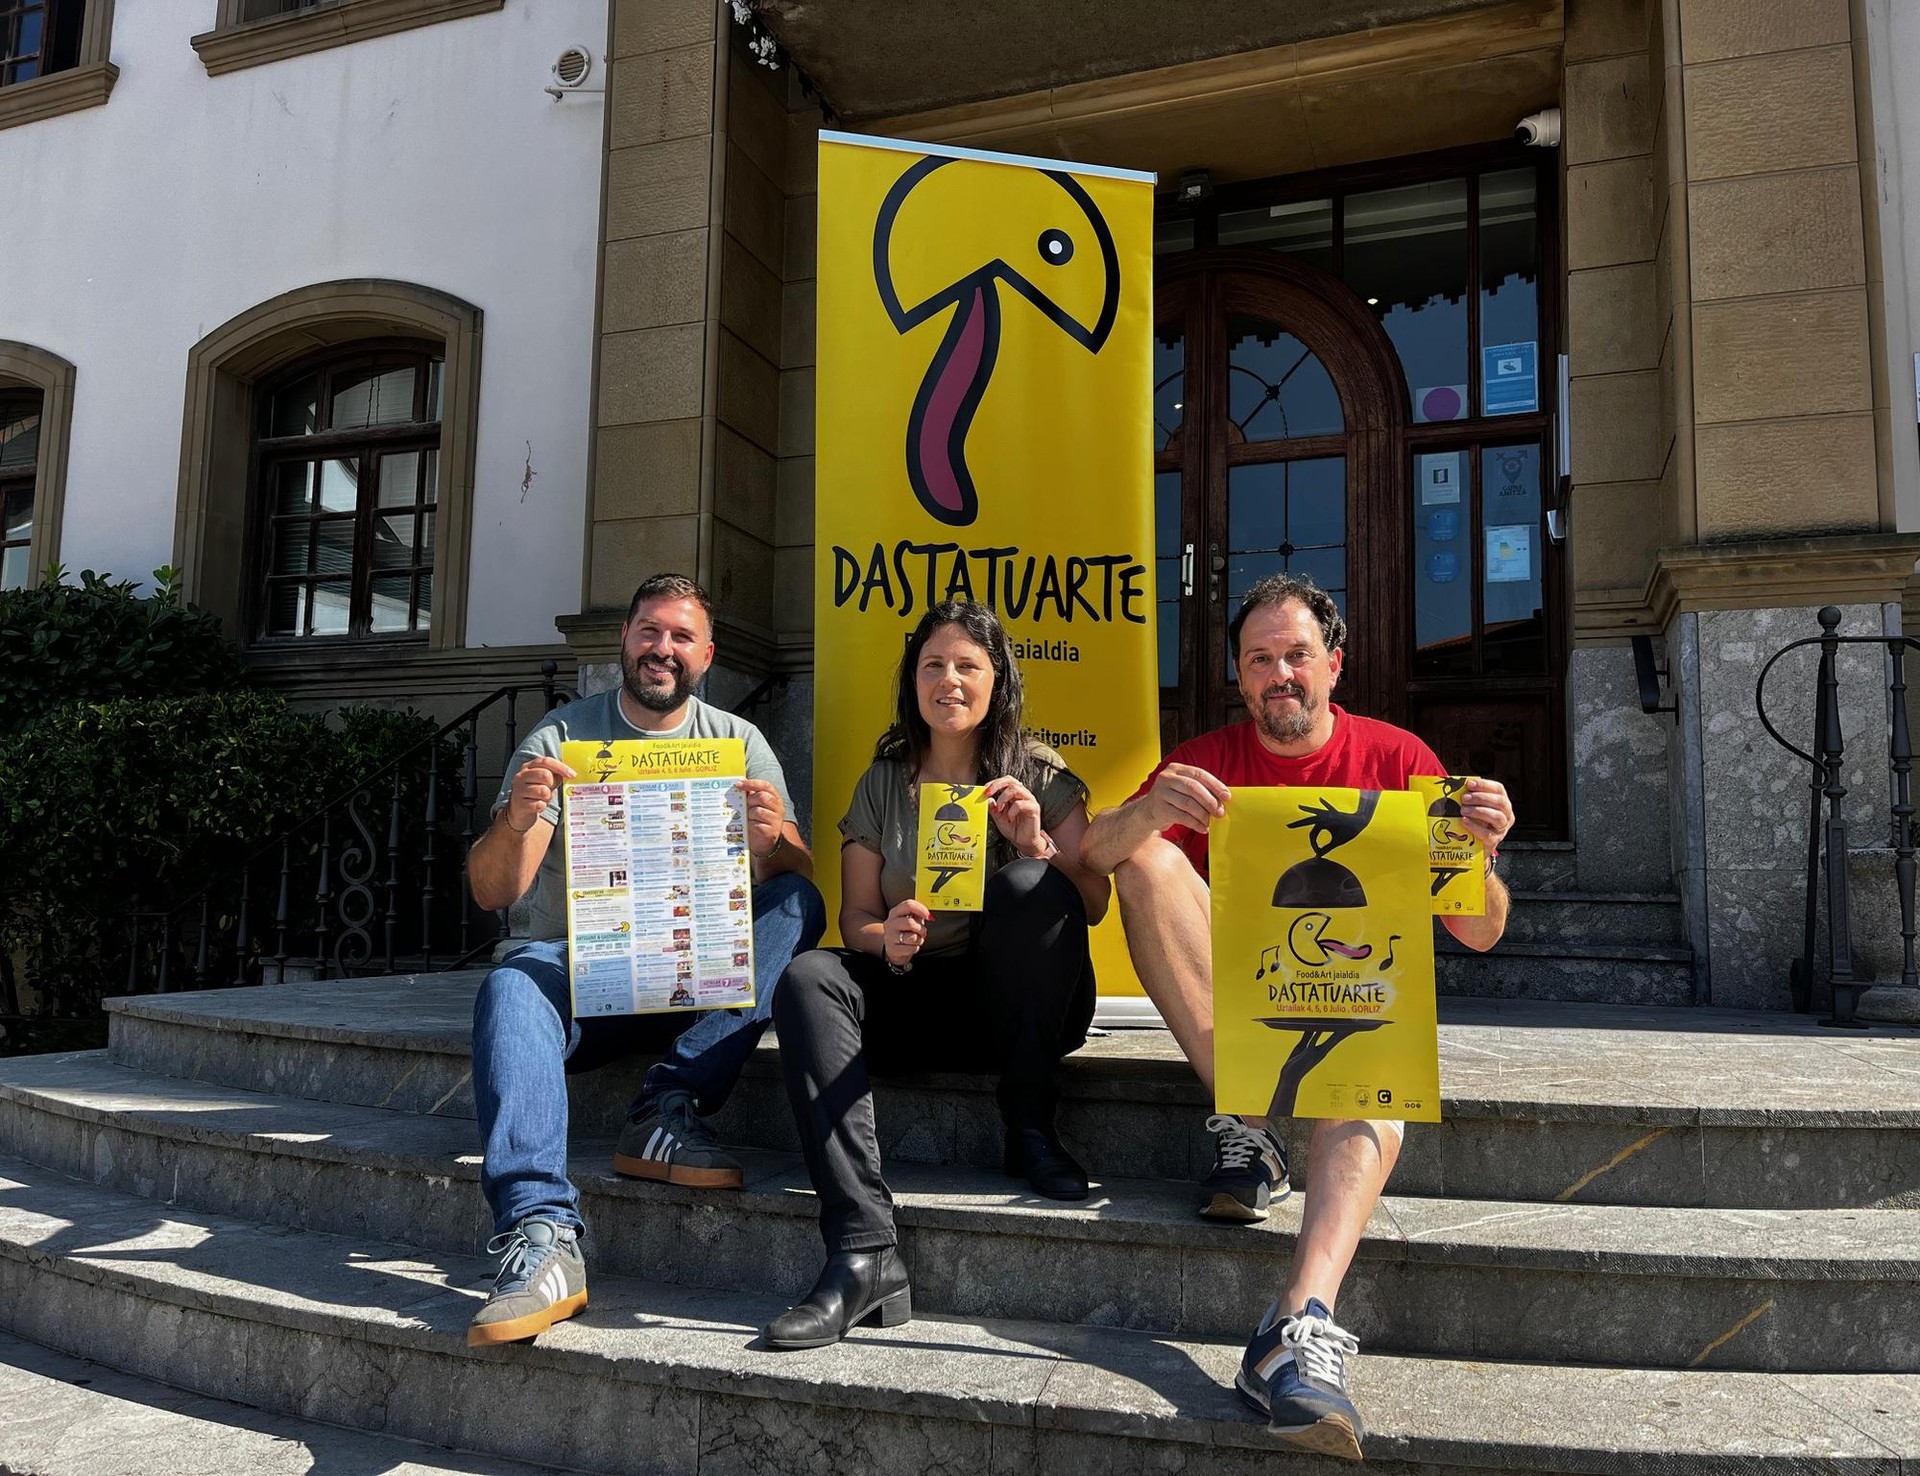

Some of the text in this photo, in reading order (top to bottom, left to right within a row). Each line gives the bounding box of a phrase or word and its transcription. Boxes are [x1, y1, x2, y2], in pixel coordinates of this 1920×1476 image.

[831, 540, 1146, 623] DASTATUARTE
[631, 750, 720, 768] DASTATUARTE
[1296, 970, 1360, 980] Food&Art jaialdia
[1268, 982, 1386, 1003] DASTATUARTE
[1276, 1003, 1306, 1013] Uztailak
[1323, 1004, 1328, 1013] 6
[1329, 1004, 1346, 1013] Julio
[1351, 1004, 1381, 1014] GORLIZ
